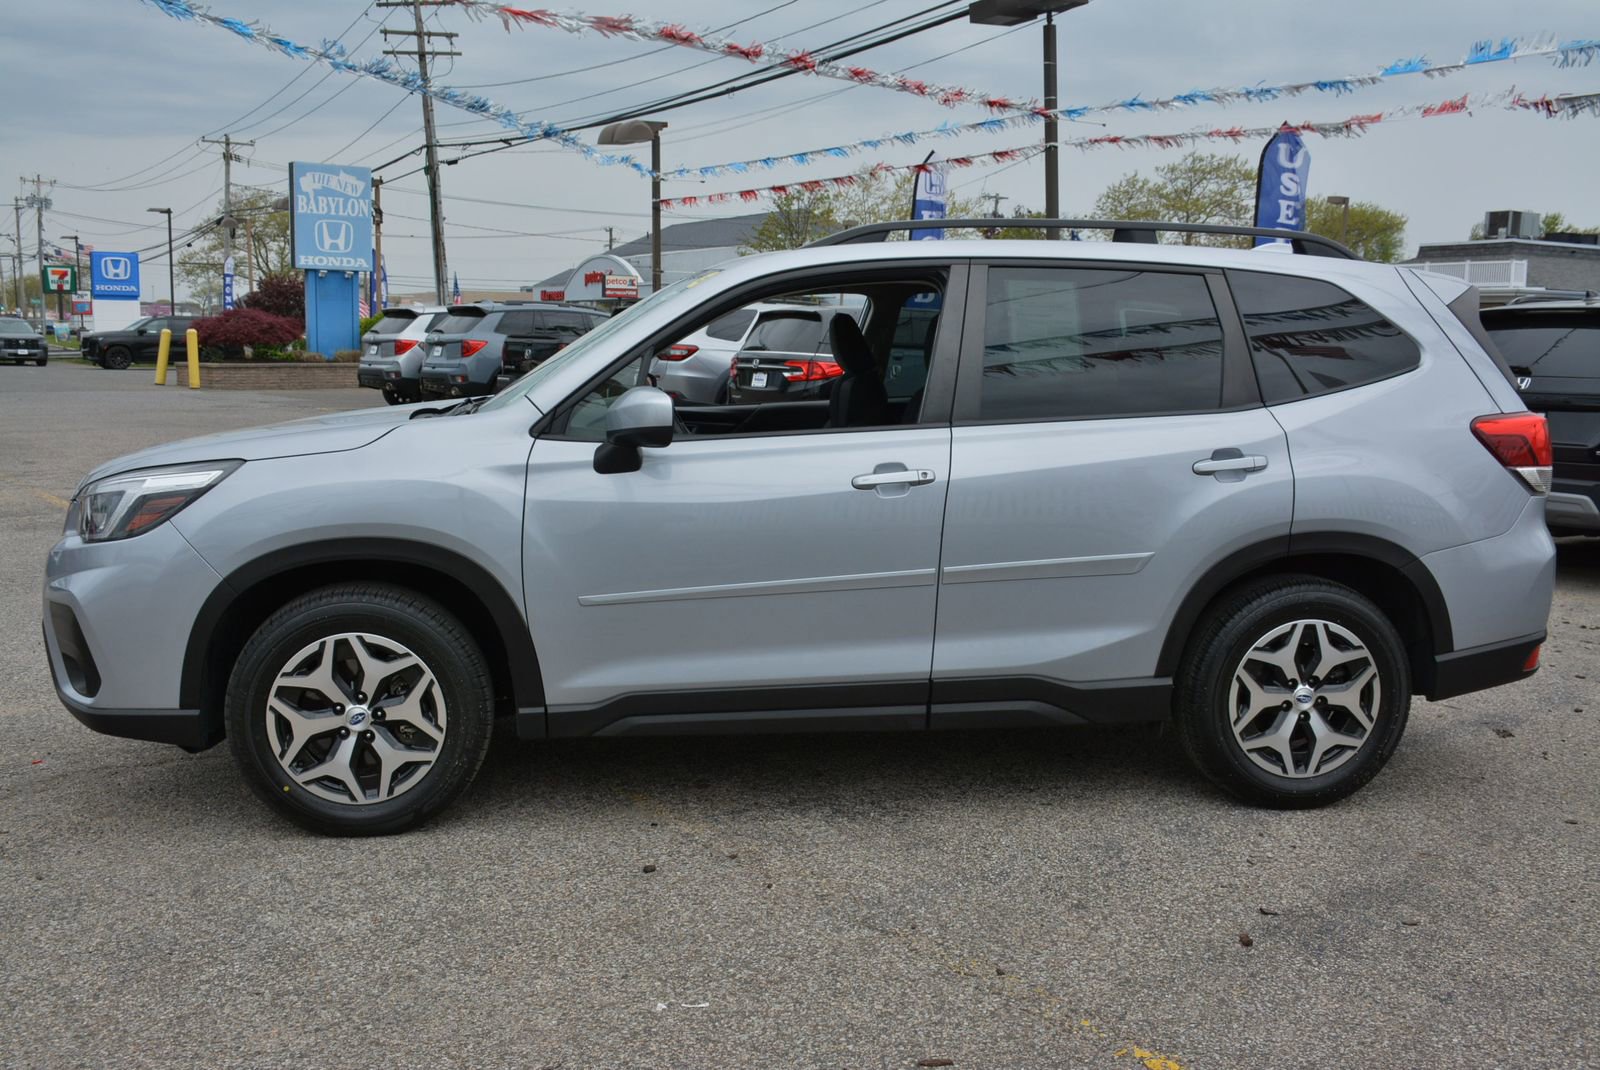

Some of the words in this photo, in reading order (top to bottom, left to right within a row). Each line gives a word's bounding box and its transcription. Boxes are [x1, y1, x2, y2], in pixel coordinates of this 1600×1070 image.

[311, 173, 331, 187] THE
[335, 177, 360, 196] NEW
[297, 194, 370, 218] BABYLON
[299, 255, 369, 268] HONDA
[95, 284, 137, 292] HONDA
[607, 277, 627, 286] petco
